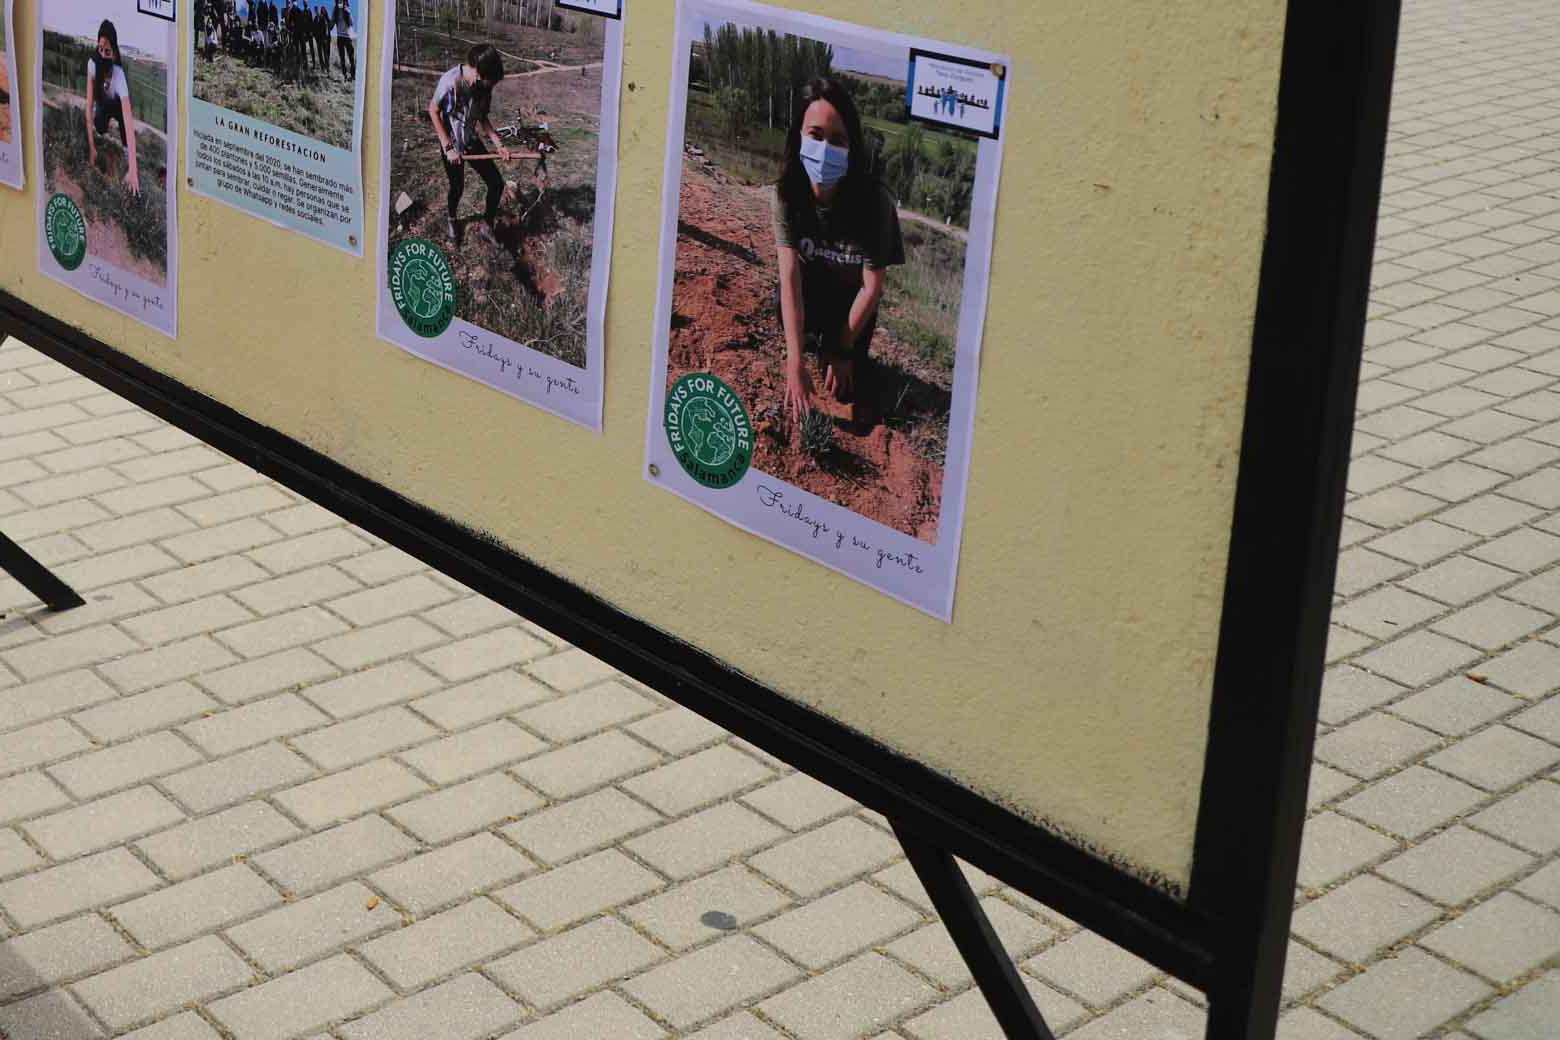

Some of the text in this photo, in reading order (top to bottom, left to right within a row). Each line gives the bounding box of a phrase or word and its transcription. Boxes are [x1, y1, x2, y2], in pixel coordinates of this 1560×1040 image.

[215, 116, 225, 127] LA
[228, 120, 250, 136] GRAN
[262, 174, 270, 184] 10
[296, 188, 325, 205] personas
[326, 199, 339, 212] que
[284, 163, 292, 172] se
[292, 165, 304, 176] han
[305, 172, 338, 188] sembrado
[53, 196, 67, 209] FOR
[306, 202, 338, 220] organizan
[392, 243, 454, 310] FRIDAYS FOR FUTURE
[457, 330, 513, 372] Fridays
[516, 363, 523, 379] y
[668, 379, 749, 453] FRIDAYS FOR FUTURE
[756, 484, 831, 537] Fridays
[836, 530, 845, 549] y
[876, 547, 925, 574] gente
